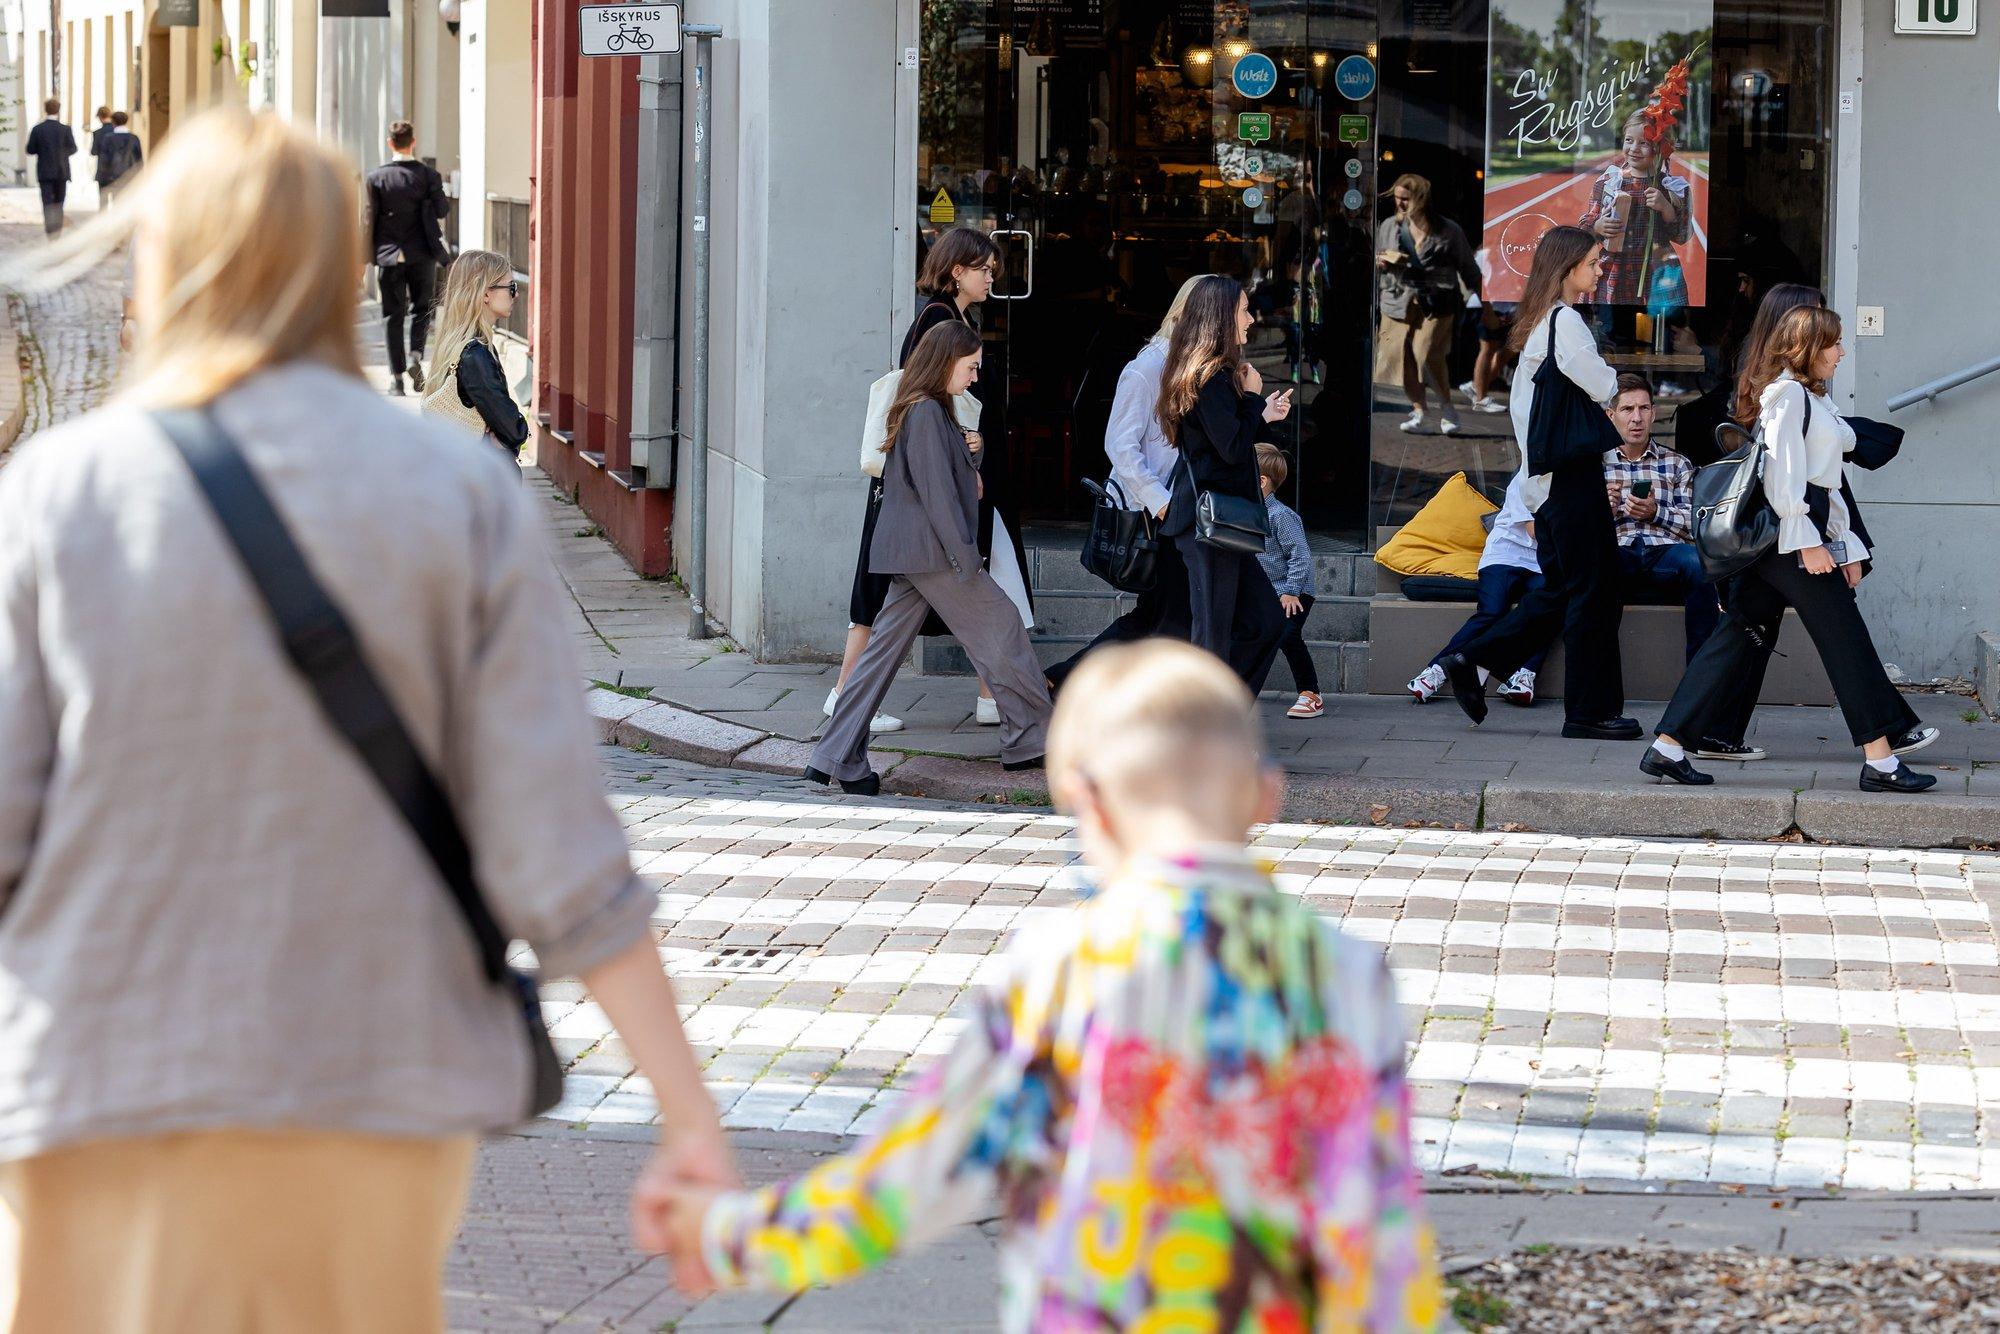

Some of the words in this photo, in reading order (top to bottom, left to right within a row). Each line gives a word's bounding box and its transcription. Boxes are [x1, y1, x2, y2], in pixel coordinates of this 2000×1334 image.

[598, 9, 661, 22] IŠSKYRUS
[1240, 69, 1270, 82] Wolt
[1509, 68, 1559, 110] Su
[1100, 541, 1126, 556] BAG
